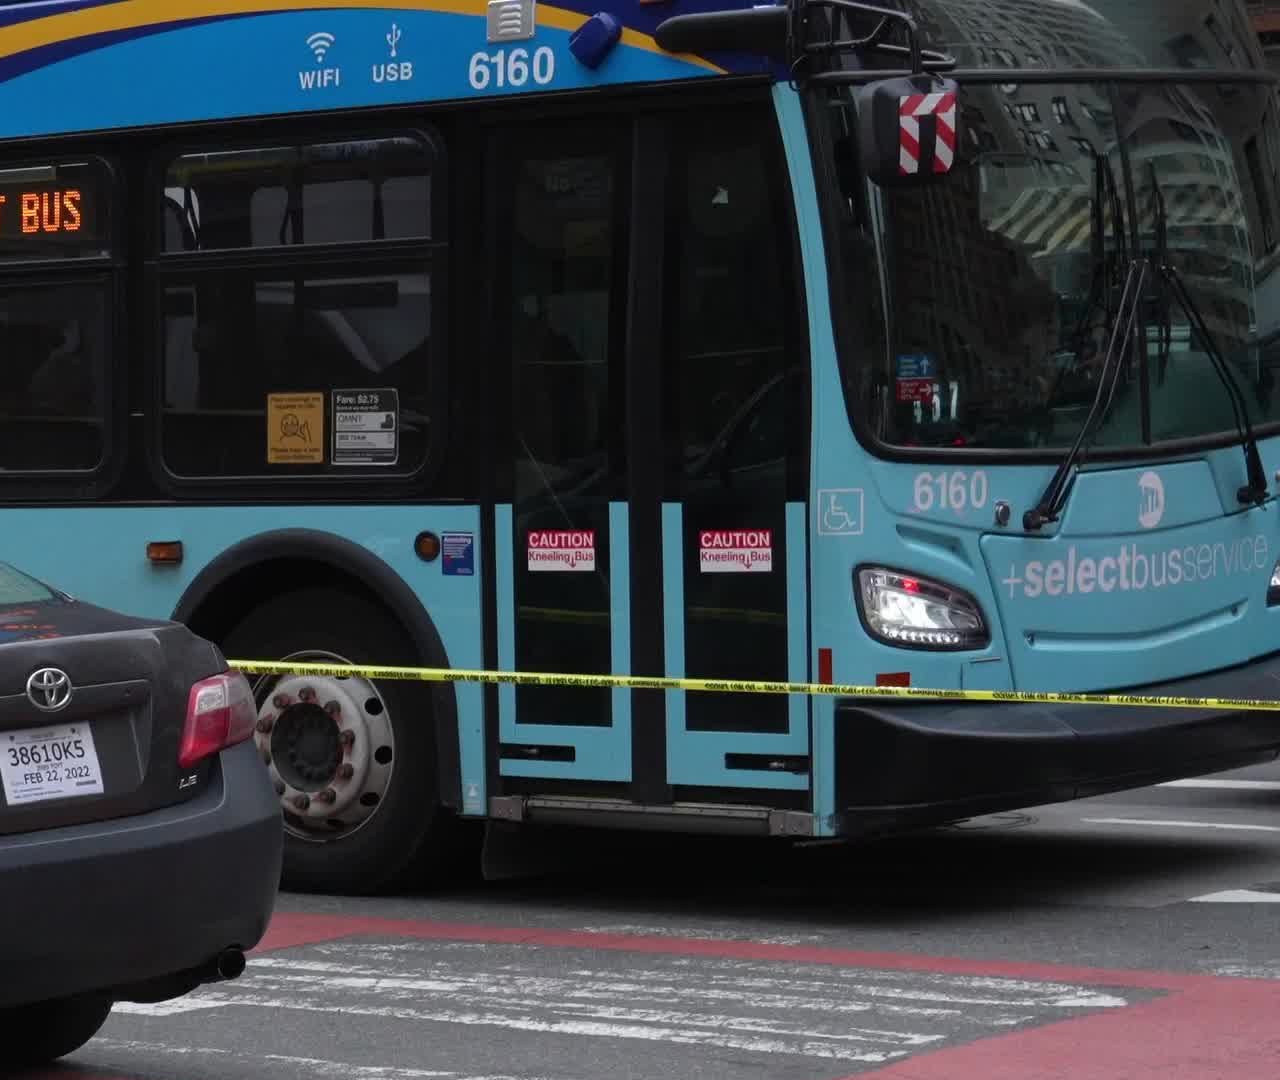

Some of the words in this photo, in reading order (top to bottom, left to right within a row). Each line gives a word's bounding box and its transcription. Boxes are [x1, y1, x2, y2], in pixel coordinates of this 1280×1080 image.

[299, 68, 339, 89] WIFI
[372, 62, 413, 83] USB
[469, 46, 555, 90] 6160
[21, 190, 81, 233] BUS
[914, 470, 988, 510] 6160
[528, 532, 594, 548] CAUTION
[701, 532, 770, 548] CAUTION
[528, 551, 570, 563] Kneeling
[575, 551, 594, 562] Bus
[701, 551, 745, 564] Kneeling
[750, 551, 770, 562] Bus
[8, 740, 85, 767] 38610K5
[24, 772, 43, 784] FEB
[47, 770, 62, 782] 22,
[65, 766, 90, 779] 2022
